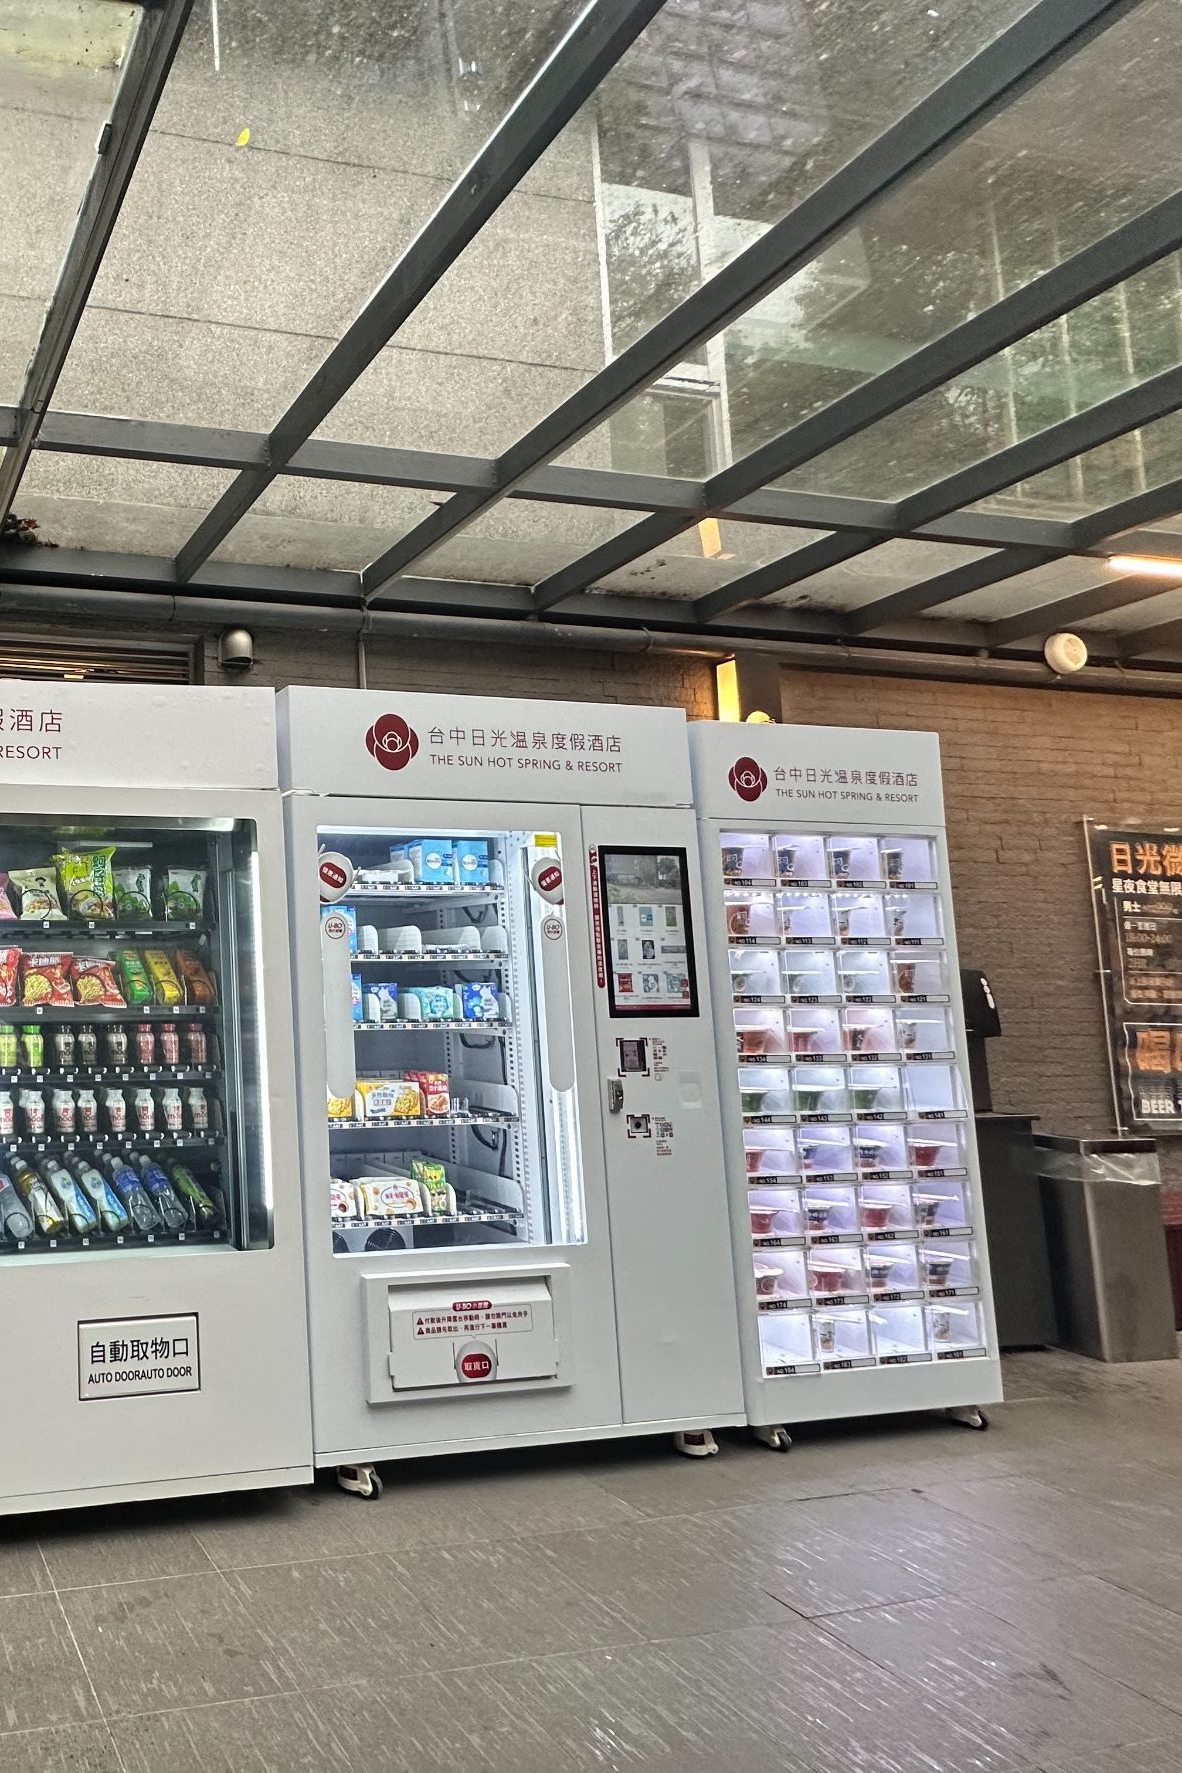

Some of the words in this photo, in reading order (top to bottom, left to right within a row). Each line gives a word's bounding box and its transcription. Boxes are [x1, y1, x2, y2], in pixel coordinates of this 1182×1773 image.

[429, 754, 454, 766] THE
[458, 755, 483, 767] SUN
[487, 757, 514, 768] HOT
[517, 758, 561, 770] SPRING
[565, 760, 574, 771] &
[577, 761, 622, 773] RESORT
[775, 788, 794, 798] THE
[796, 789, 815, 799] SUN
[818, 790, 838, 800] HOT
[840, 791, 872, 801] SPRING
[875, 792, 883, 801] &
[885, 793, 918, 803] RESORT
[1141, 1098, 1175, 1114] BEER
[91, 1337, 189, 1364] 自動取物口
[463, 1361, 489, 1371] 取貨口
[88, 1372, 113, 1384] AUTO
[166, 1366, 192, 1377] DOOR
